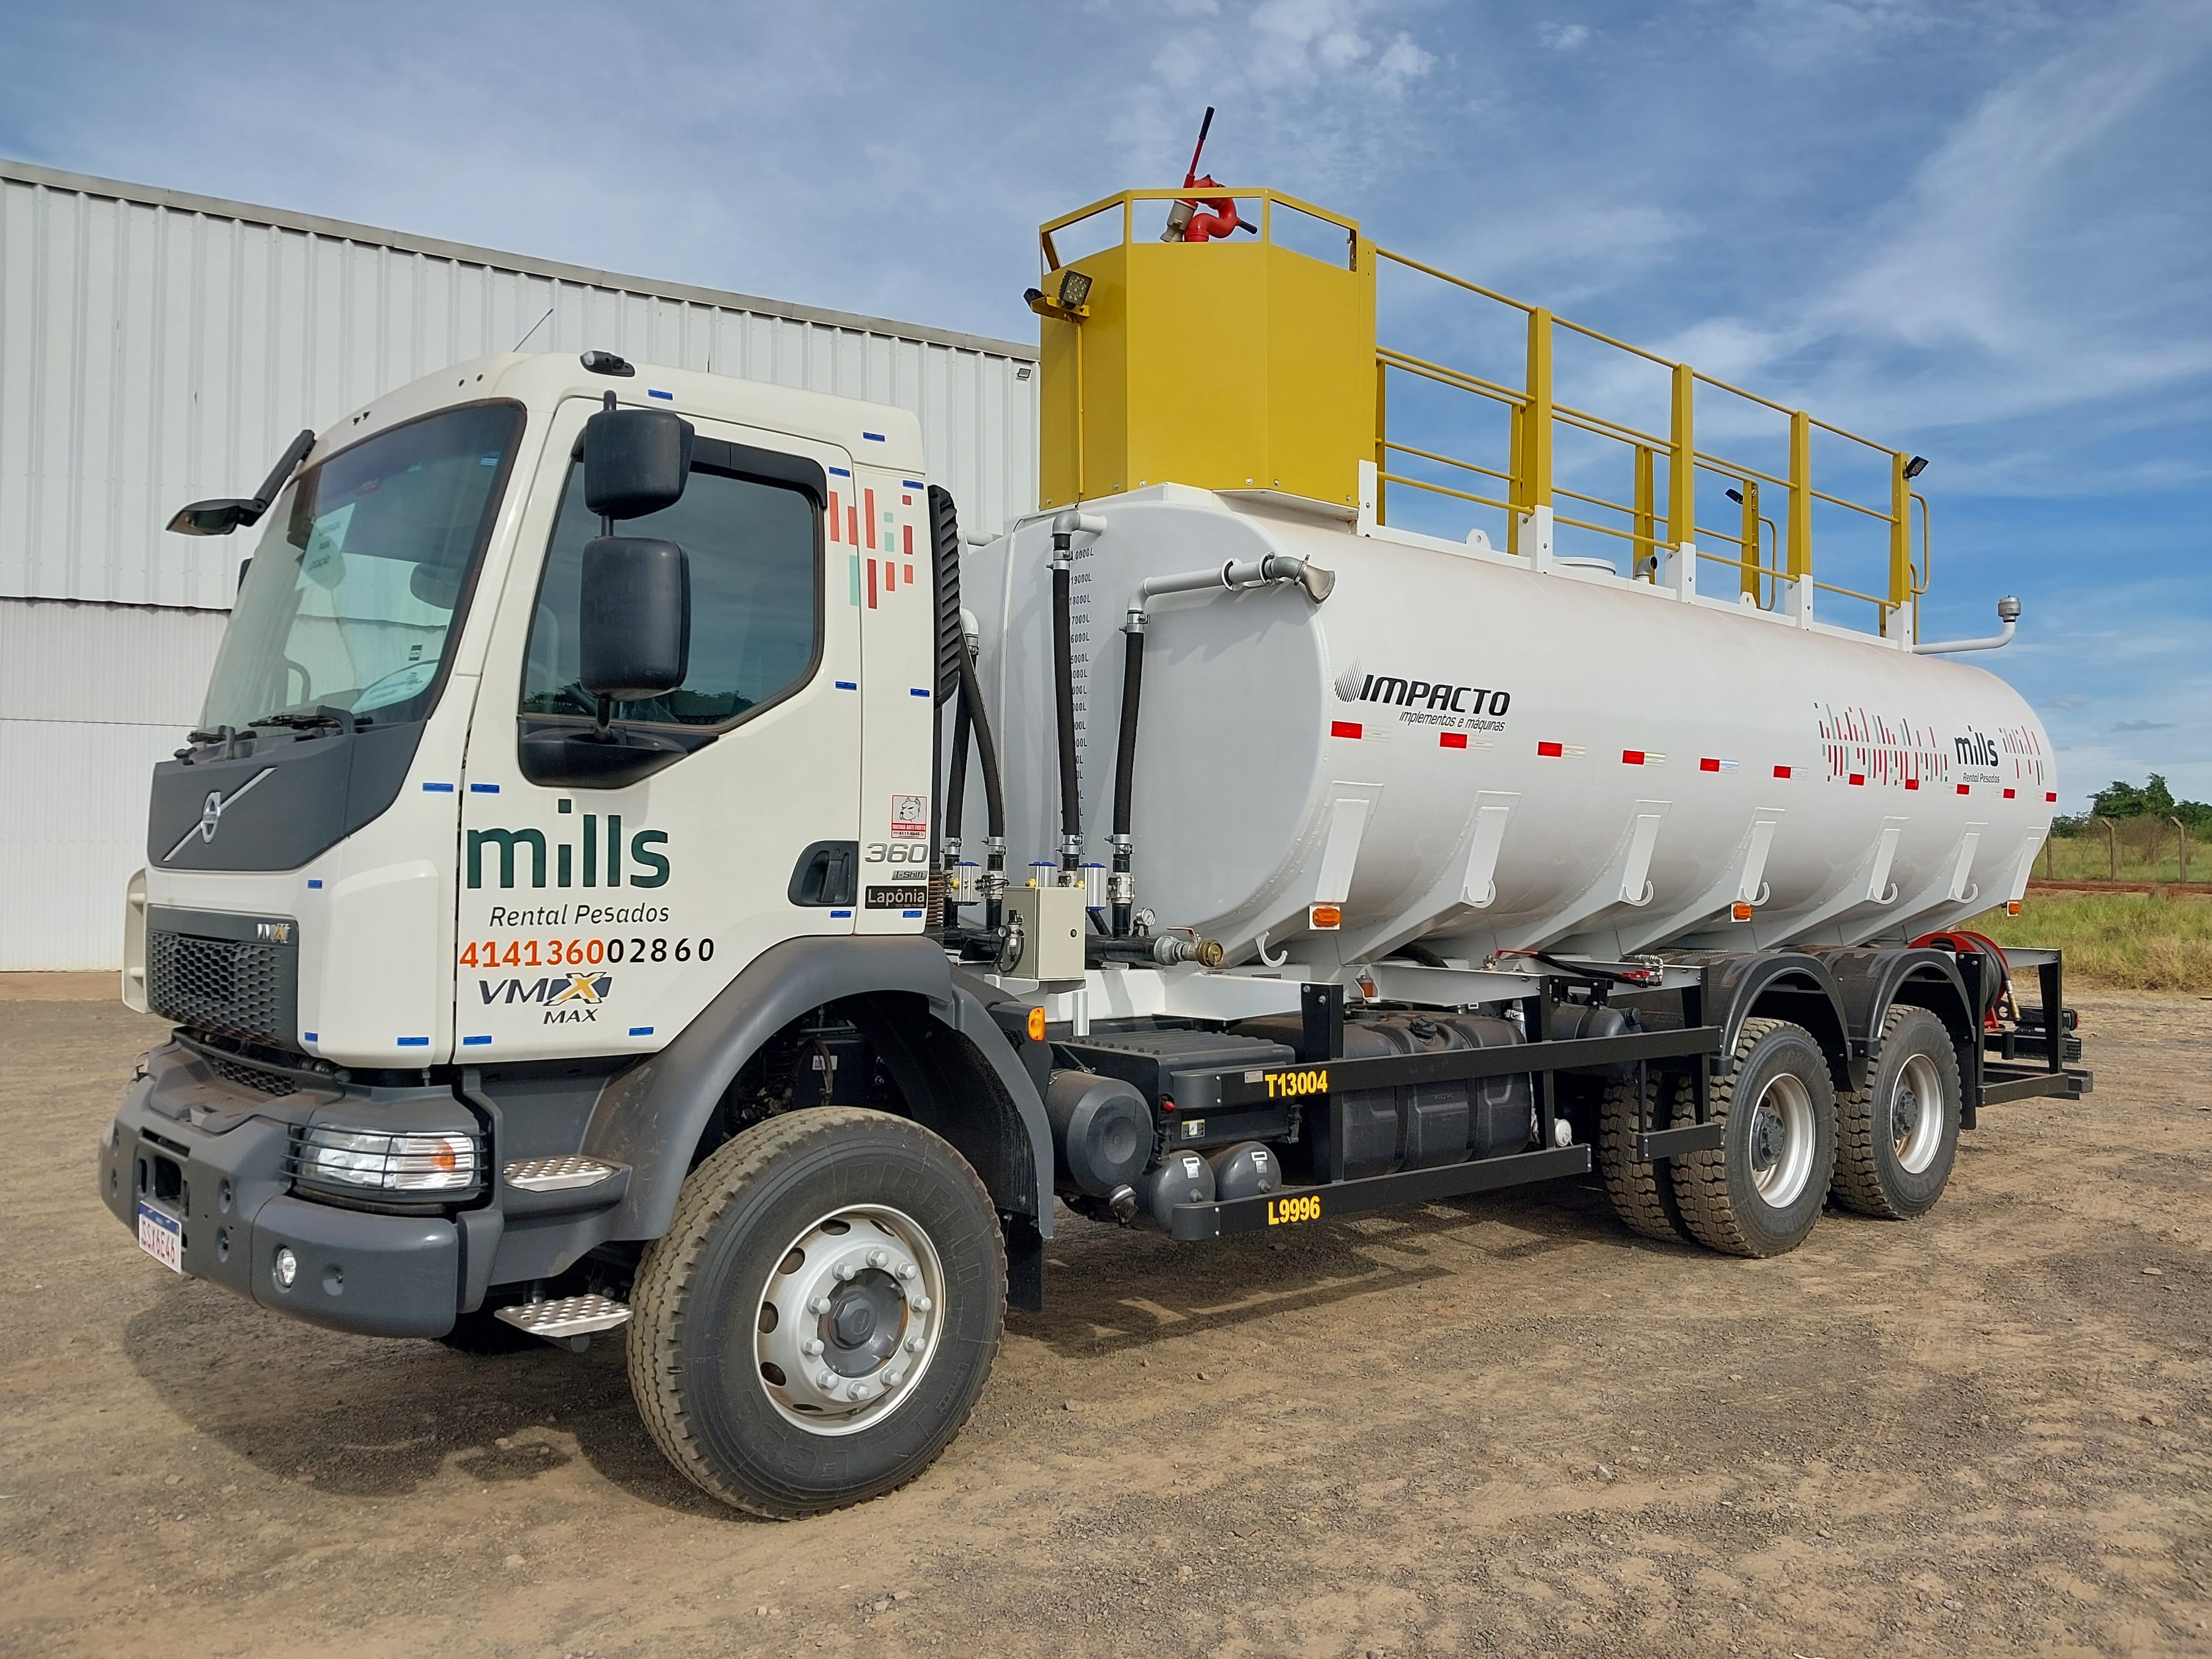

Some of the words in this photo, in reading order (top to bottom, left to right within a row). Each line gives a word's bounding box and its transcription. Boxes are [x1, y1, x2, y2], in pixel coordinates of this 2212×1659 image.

[1071, 573, 1092, 585] 19000L
[1071, 613, 1090, 625] 7000L
[1071, 632, 1090, 643] 6000L
[1359, 674, 1510, 717] IMPACTO
[1399, 711, 1456, 727] implementos
[1457, 718, 1464, 728] e
[1465, 717, 1506, 733] máquinas
[1954, 725, 1998, 767] mills
[1963, 772, 1979, 782] Rental
[1979, 773, 2000, 783] Pesados
[467, 798, 671, 889] mills
[864, 843, 929, 863] 360
[896, 870, 923, 878] I-Shift
[868, 888, 925, 907] Lapônia
[488, 903, 569, 927] Rental
[574, 902, 669, 925] Pesados
[543, 1008, 599, 1025] MAX
[1265, 1070, 1328, 1098] T13004
[1268, 1195, 1321, 1225] L9996
